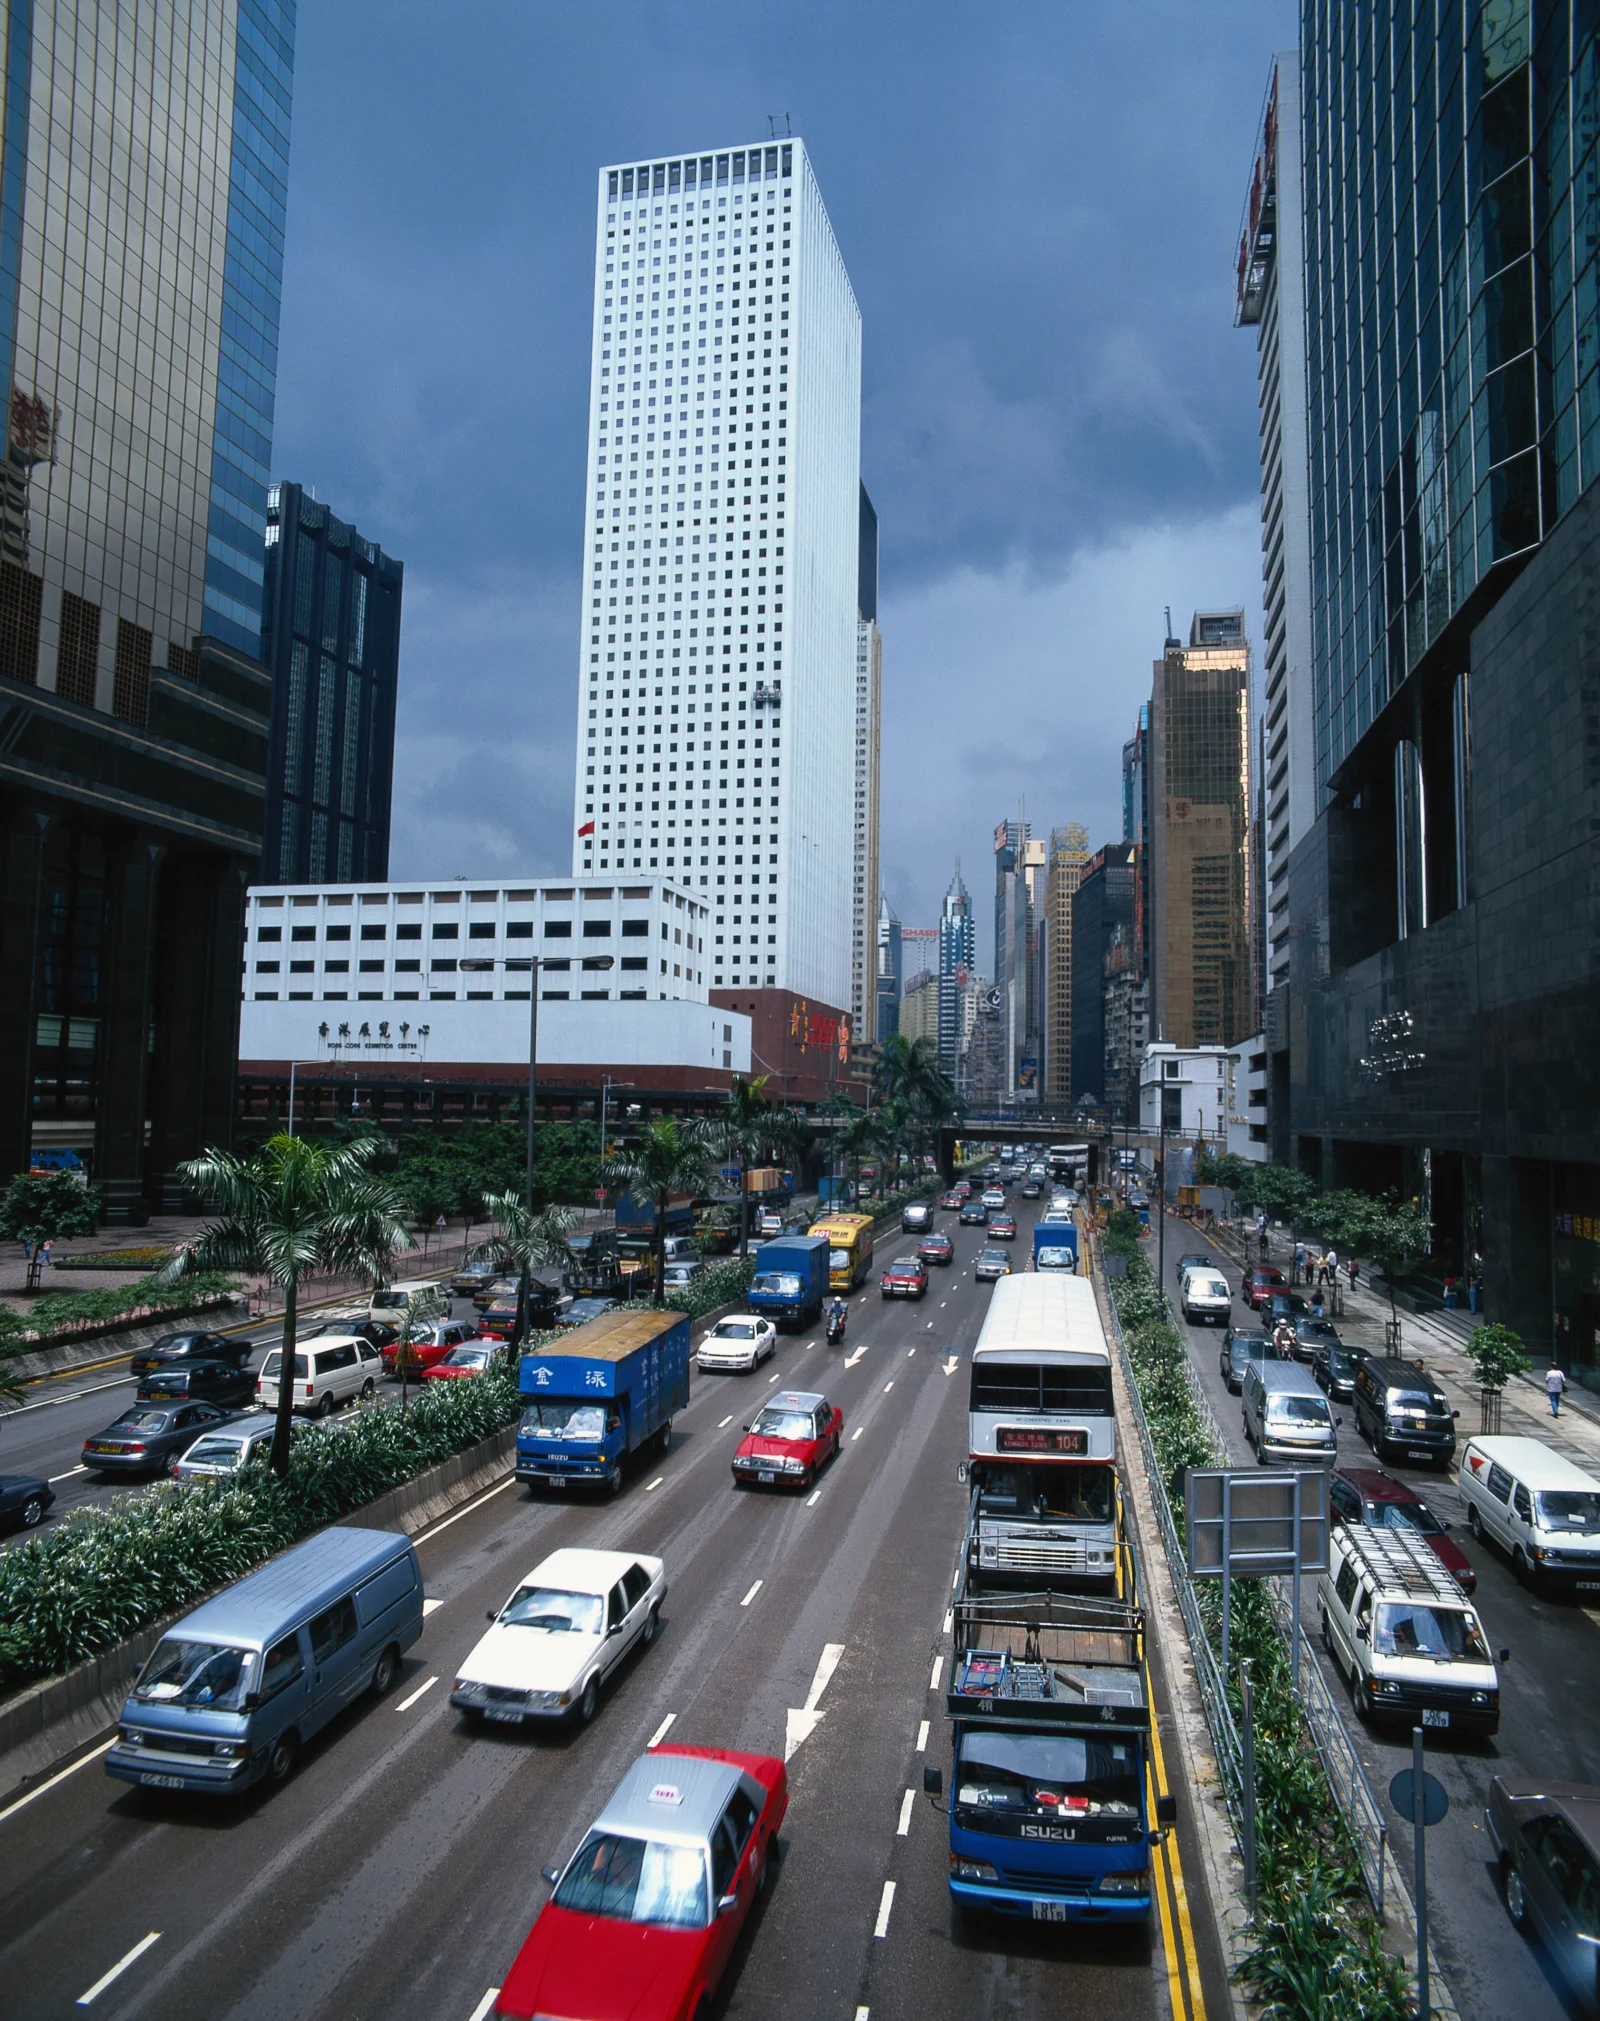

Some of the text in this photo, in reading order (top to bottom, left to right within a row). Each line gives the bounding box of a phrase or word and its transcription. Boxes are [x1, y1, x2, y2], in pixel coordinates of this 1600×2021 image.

[901, 928, 940, 936] SHARP
[1056, 1435, 1079, 1450] 104
[1425, 1717, 1447, 1726] 7219
[1020, 1825, 1076, 1840] ISUZU
